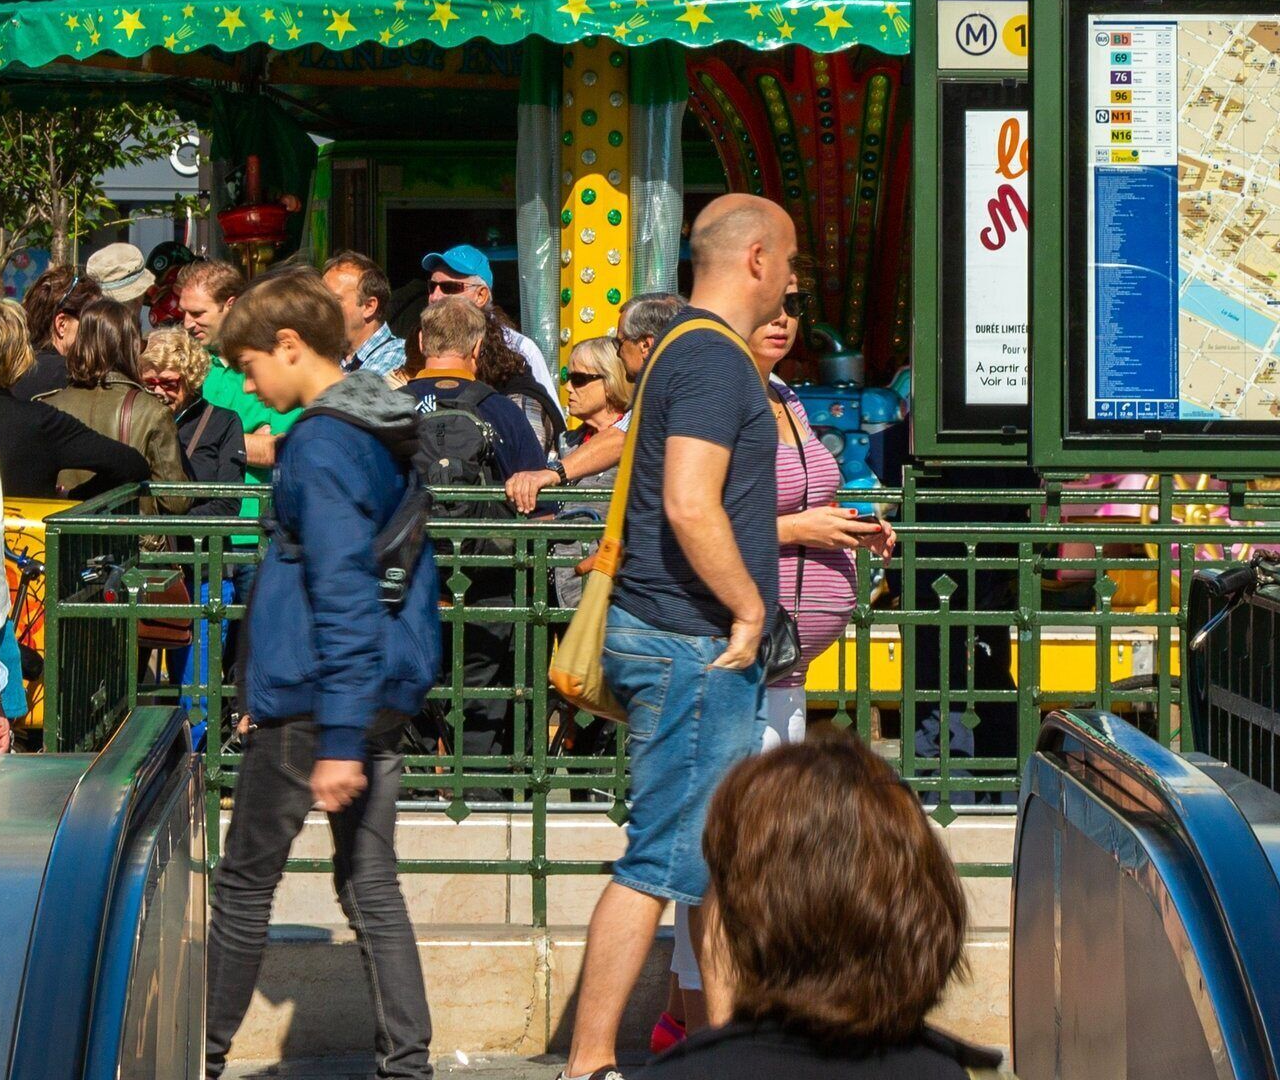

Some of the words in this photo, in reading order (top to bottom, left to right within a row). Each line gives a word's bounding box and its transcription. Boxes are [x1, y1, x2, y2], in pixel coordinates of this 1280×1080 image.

[1014, 24, 1026, 47] 1
[1113, 35, 1129, 44] Bb
[1115, 53, 1127, 63] 69
[1115, 72, 1128, 82] 76
[1115, 91, 1128, 101] 96
[1111, 112, 1131, 121] N11
[1111, 131, 1132, 140] N16
[975, 323, 1000, 334] DURÉE
[1001, 323, 1028, 334] LIMITÉ
[1002, 343, 1020, 354] Pour
[975, 361, 985, 372] À
[989, 364, 1020, 374] partir
[980, 376, 1002, 386] Voir
[1006, 377, 1017, 386] la
